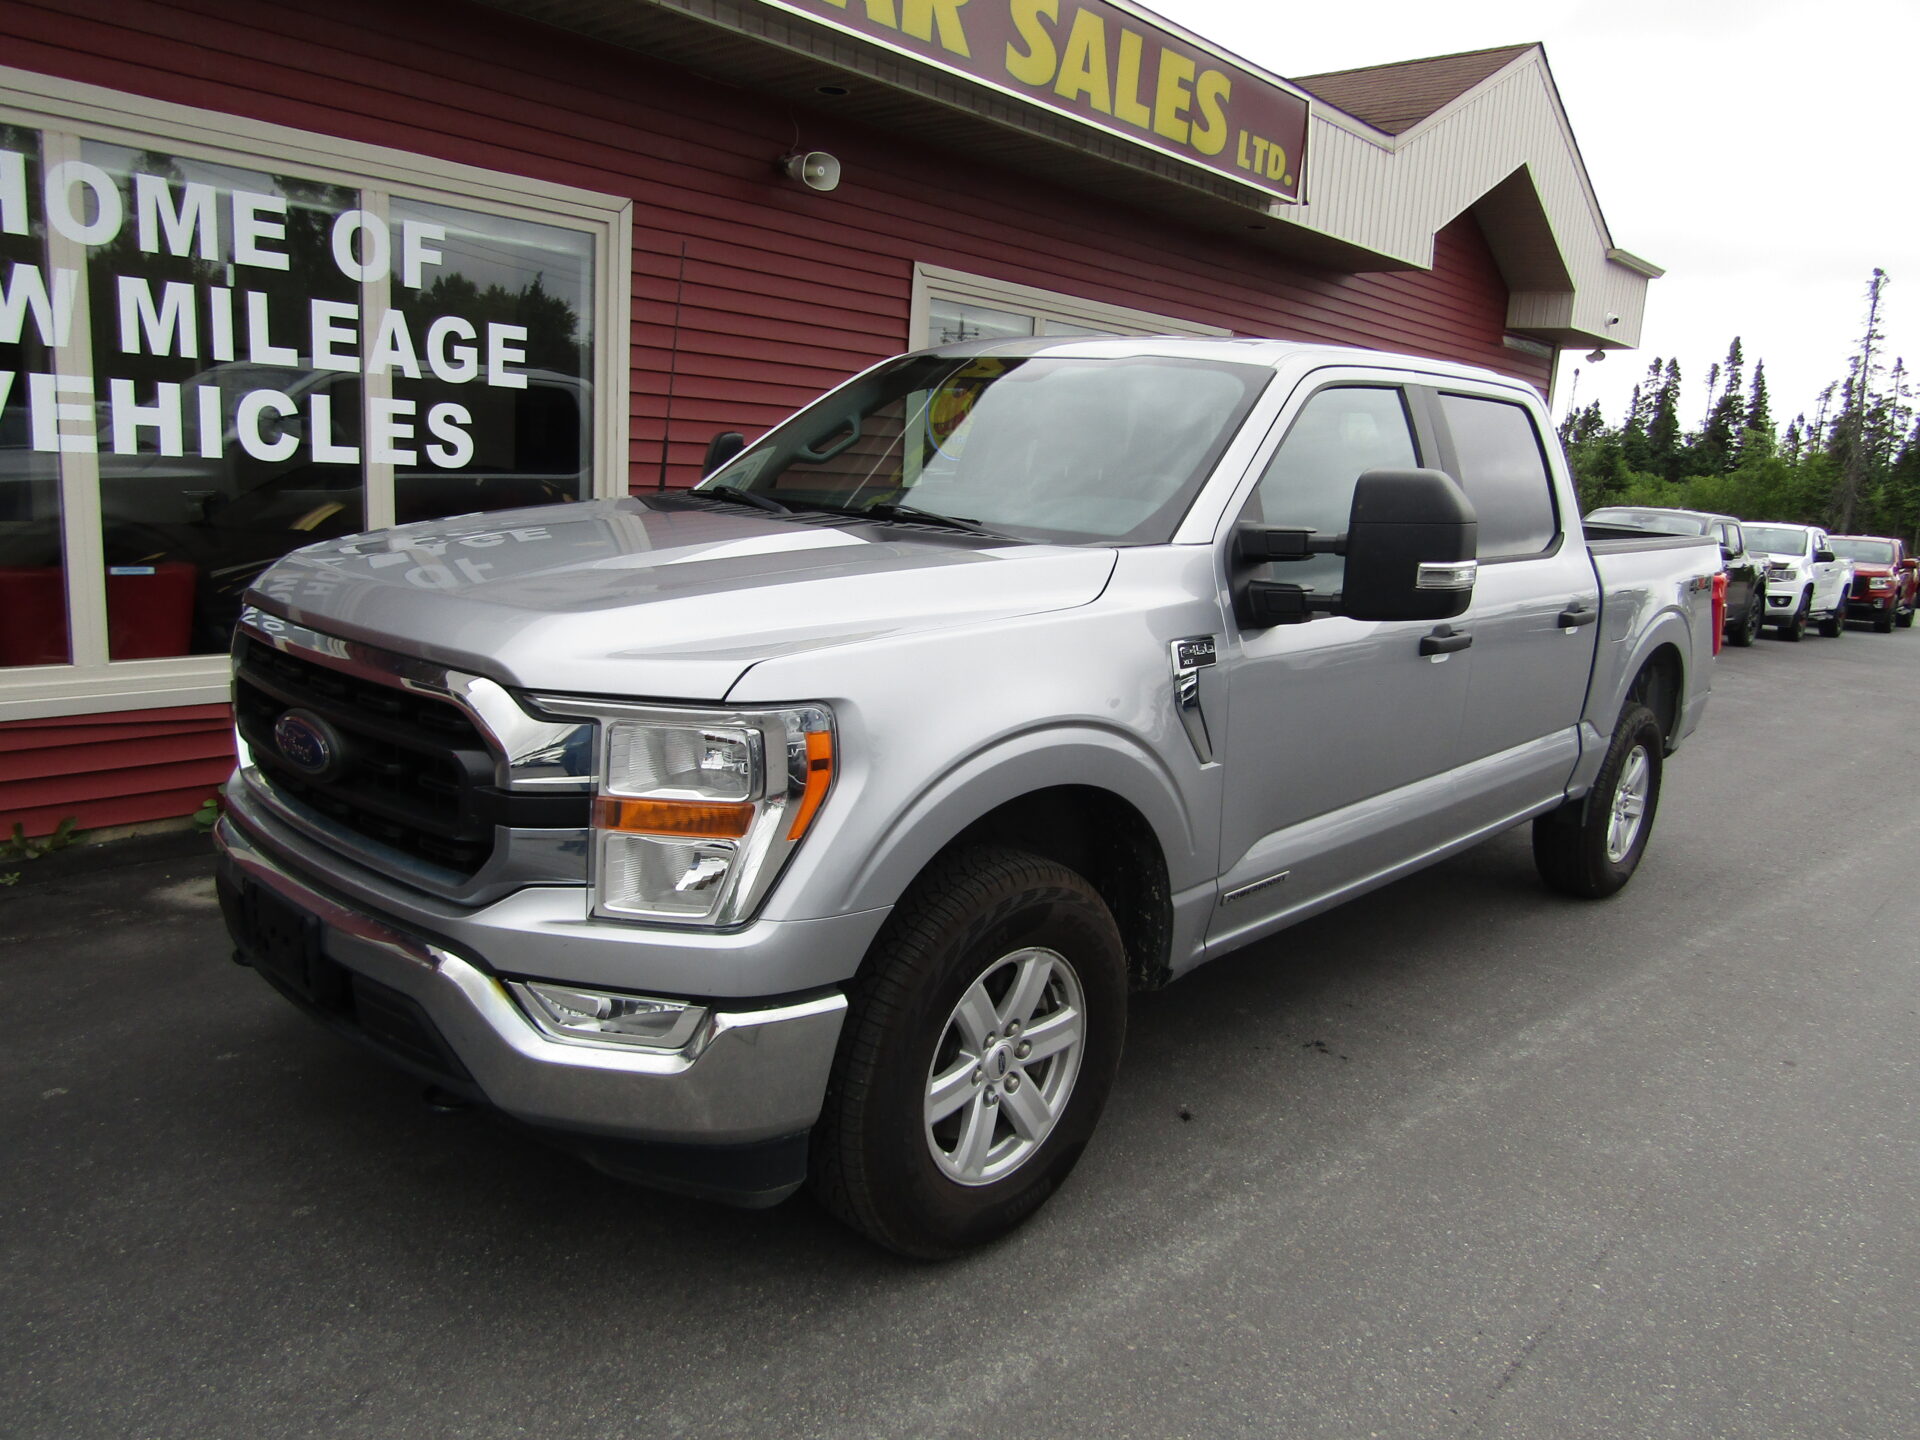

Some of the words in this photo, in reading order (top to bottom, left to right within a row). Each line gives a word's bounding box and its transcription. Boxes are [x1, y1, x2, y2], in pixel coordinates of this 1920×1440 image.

[1006, 0, 1231, 156] SALES
[1237, 130, 1293, 187] LTD.
[332, 210, 446, 289] OF
[118, 276, 529, 389] MILEAGE
[0, 371, 474, 469] EHICLES
